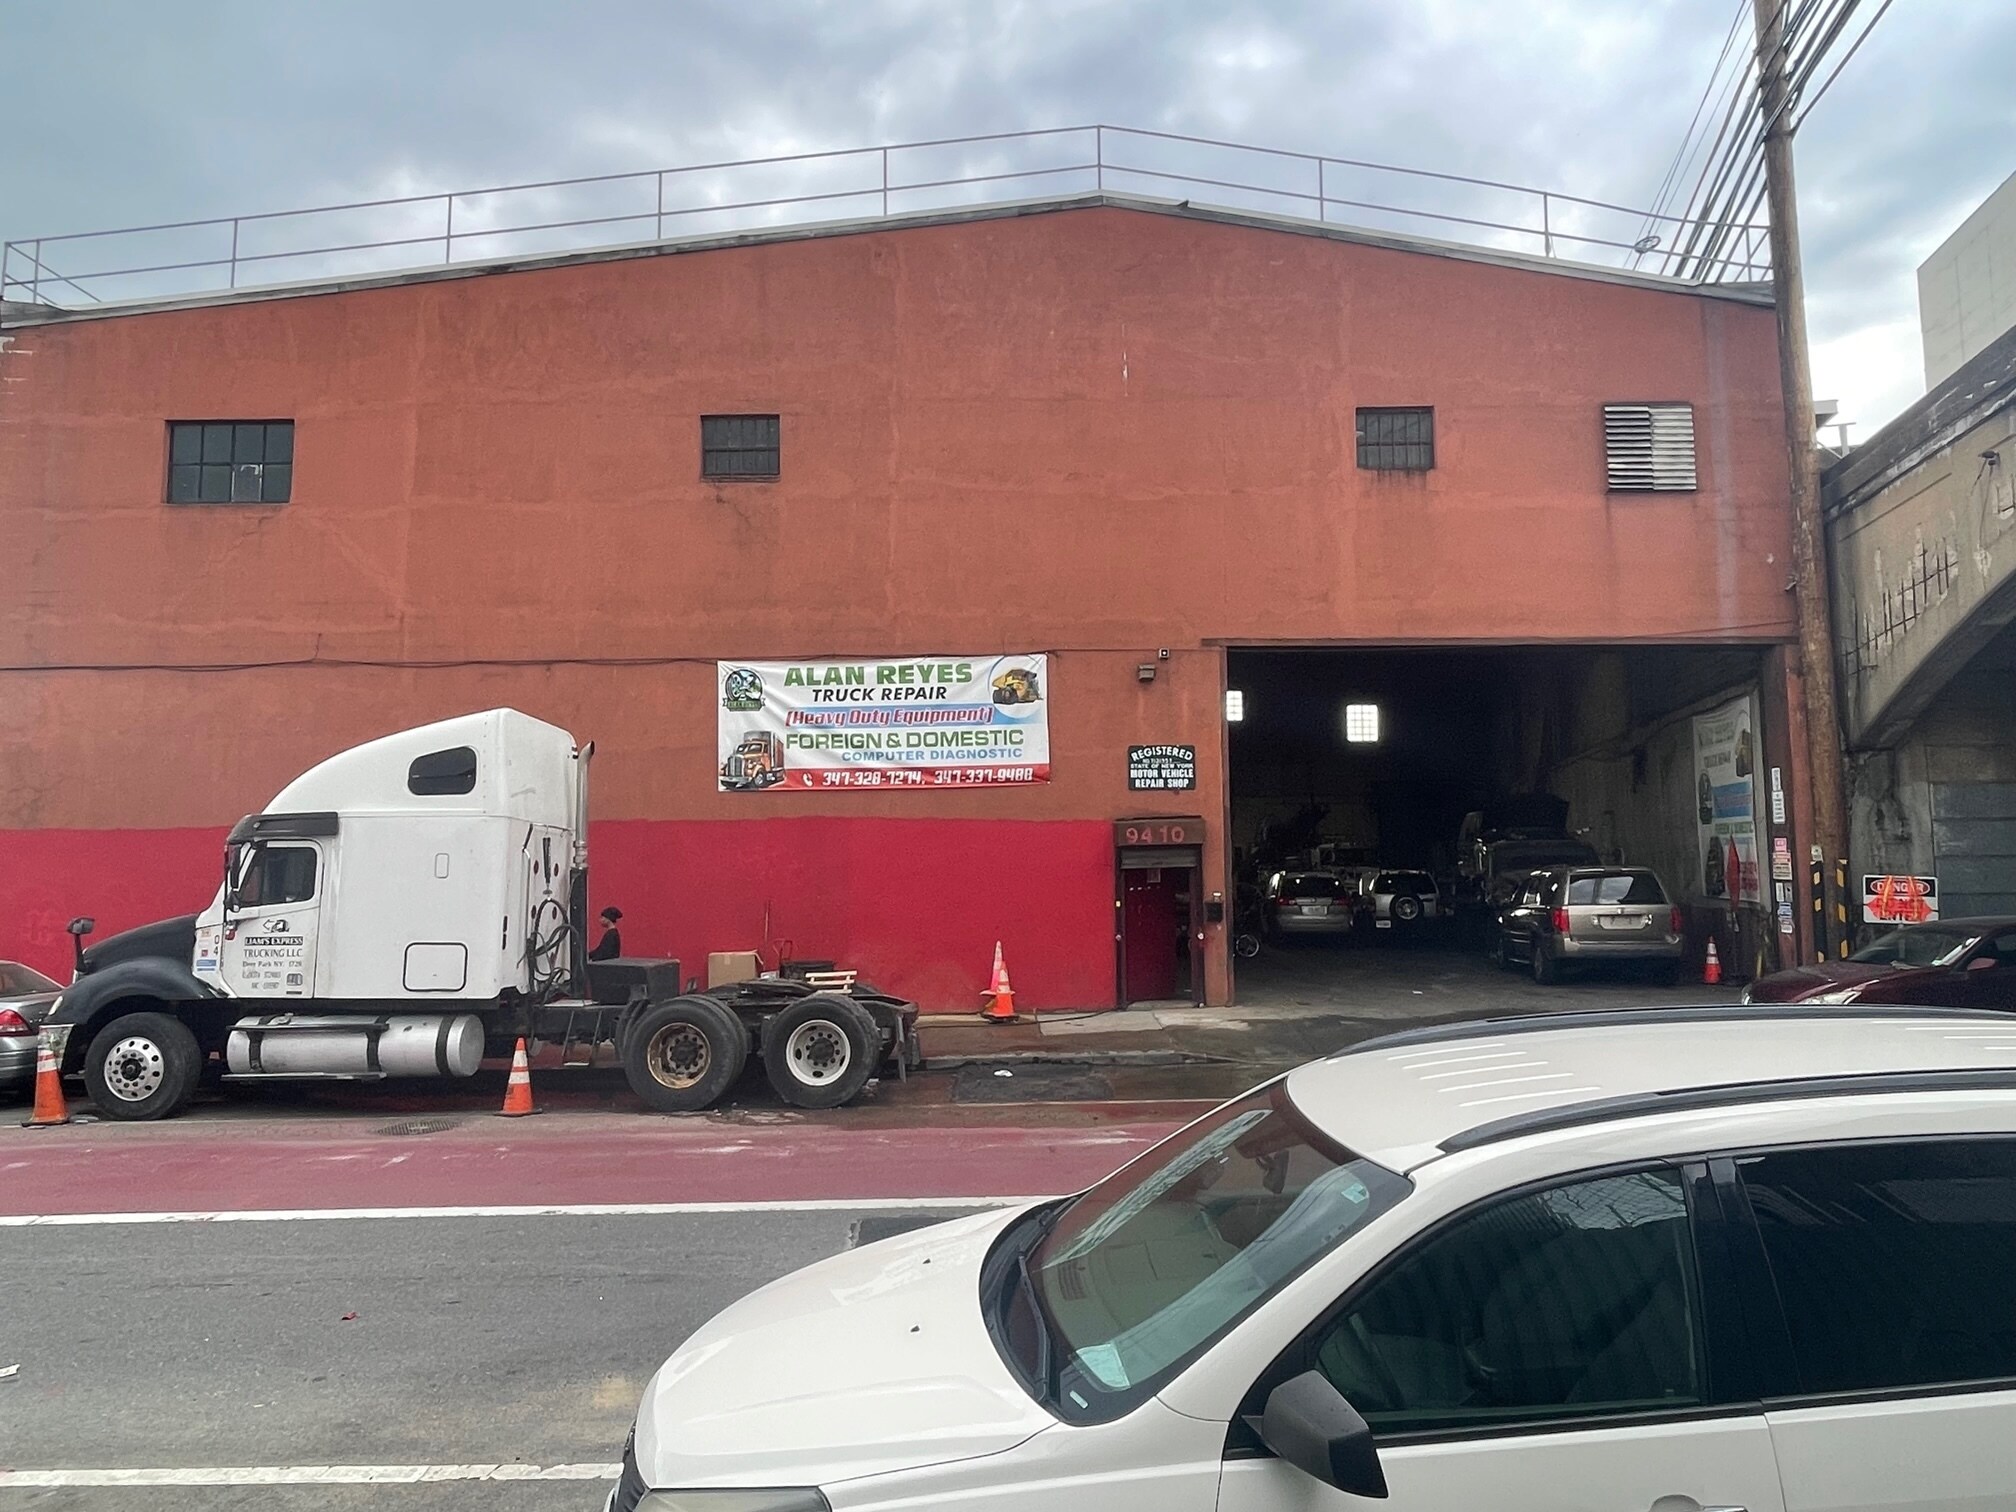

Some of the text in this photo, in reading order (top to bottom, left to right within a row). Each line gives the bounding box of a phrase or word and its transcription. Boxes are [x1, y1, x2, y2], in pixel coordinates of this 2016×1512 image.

[784, 663, 973, 686] ALAN REYES
[812, 686, 947, 702] TRUCK REPAIR
[850, 708, 890, 725] Duty
[786, 730, 1024, 749] FOREIGN & DOMESTIC
[841, 748, 1023, 762] COMPUTER DIAGNOSTIC
[1131, 746, 1193, 761] REGISTERED
[1130, 769, 1193, 778] MOTOR VEHICLE
[1135, 778, 1189, 788] REPAIR SHOP
[1877, 882, 1924, 893] DNGR
[271, 936, 303, 945] EXPRESS
[244, 948, 285, 957] TRUCKING
